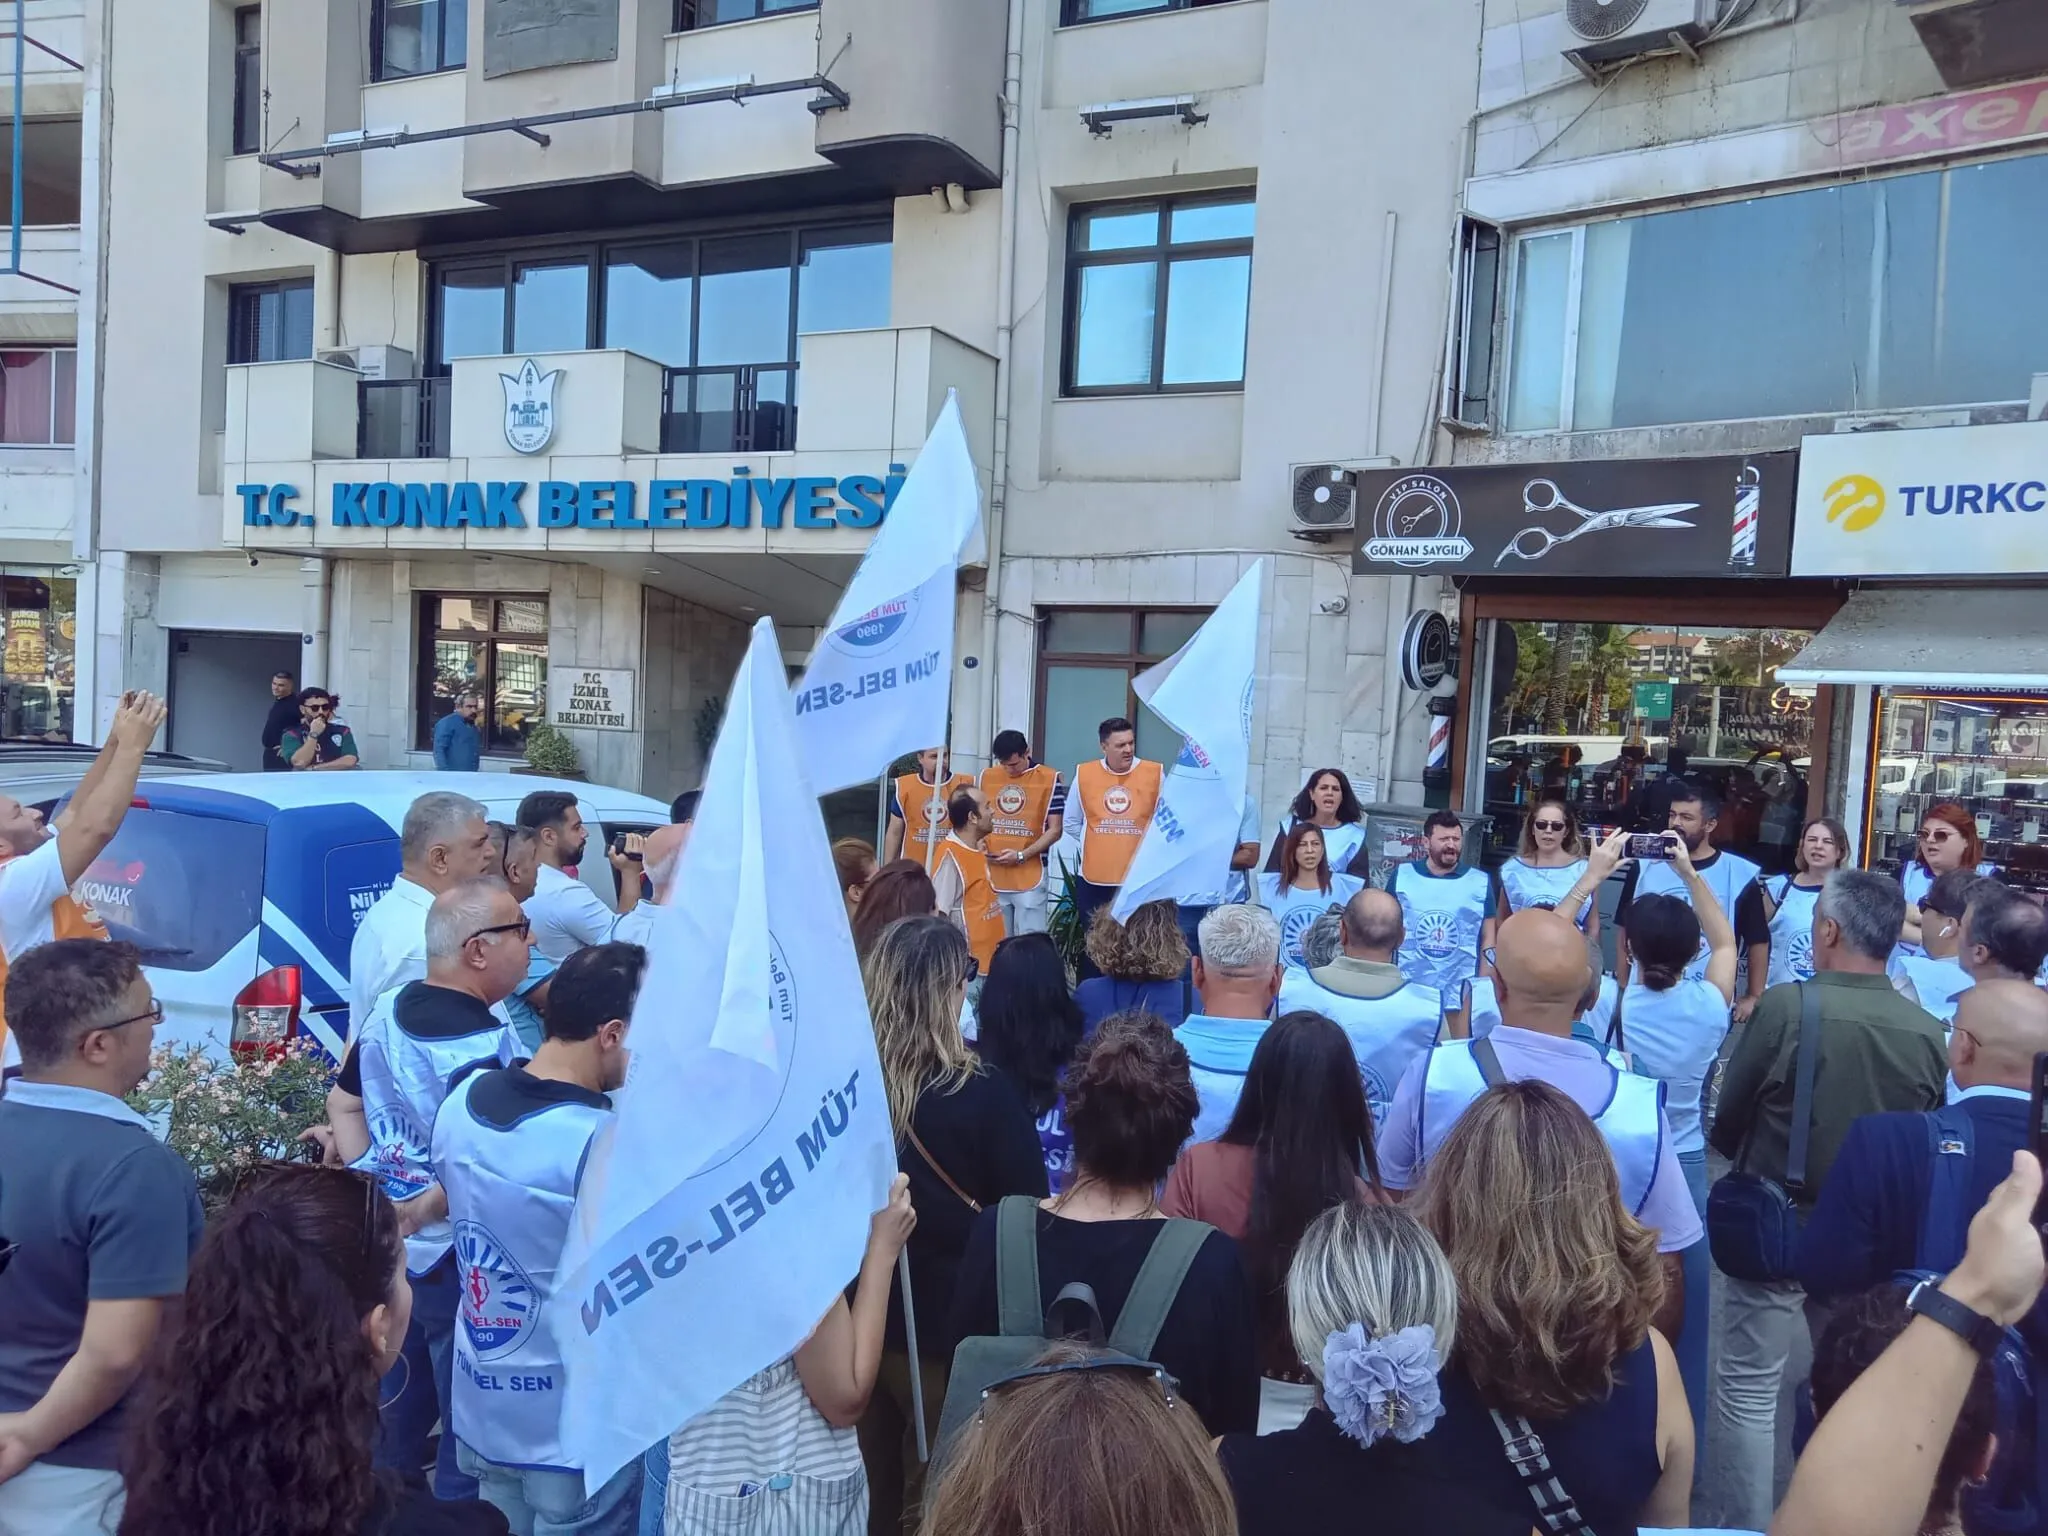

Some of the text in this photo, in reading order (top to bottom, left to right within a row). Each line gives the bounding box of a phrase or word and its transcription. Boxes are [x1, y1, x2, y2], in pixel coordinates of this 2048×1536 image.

[1389, 480, 1448, 501] VIP SALON
[1899, 480, 2047, 516] TURKC
[237, 483, 314, 527] T.C.
[332, 481, 528, 529] KONAK
[1370, 543, 1464, 556] GÖKHAN SAYGILI
[583, 673, 602, 685] T.C.
[573, 683, 609, 698] İZMİR
[570, 699, 612, 711] KONAK
[557, 712, 625, 727] BELEDİYESİ
[80, 881, 133, 906] KONAK
[510, 1375, 553, 1392] SEN
